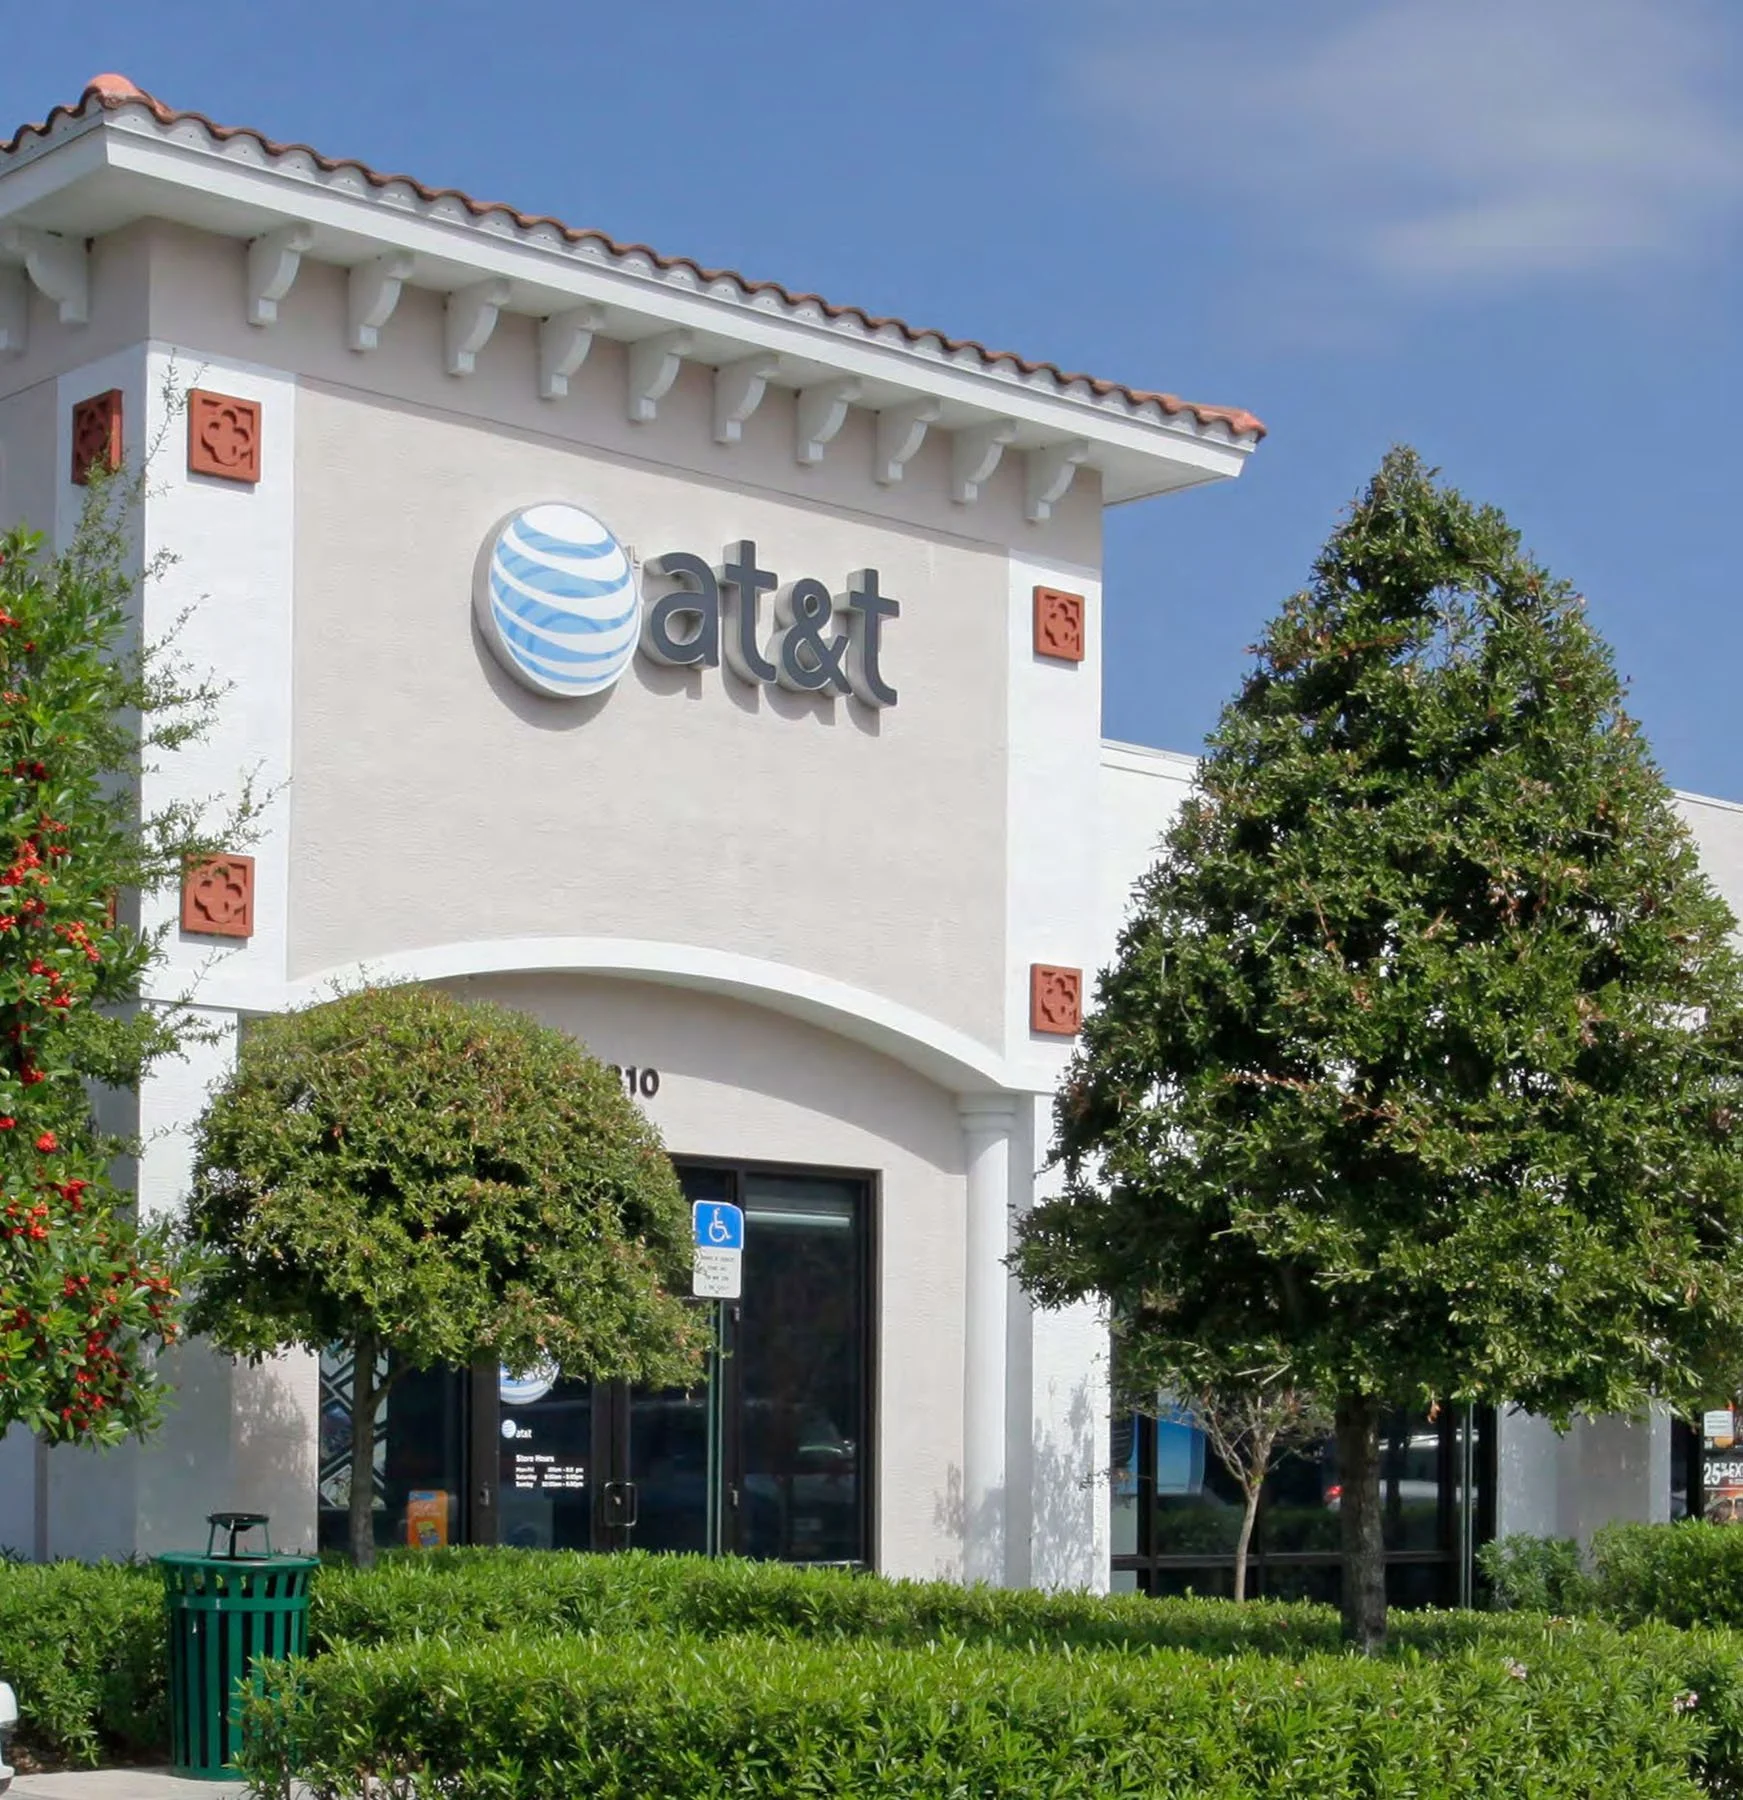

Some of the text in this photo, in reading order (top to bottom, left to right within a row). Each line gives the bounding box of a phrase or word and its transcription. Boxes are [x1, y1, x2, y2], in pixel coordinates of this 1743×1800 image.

[642, 540, 900, 707] at&t
[516, 1454, 555, 1463] Store Hours
